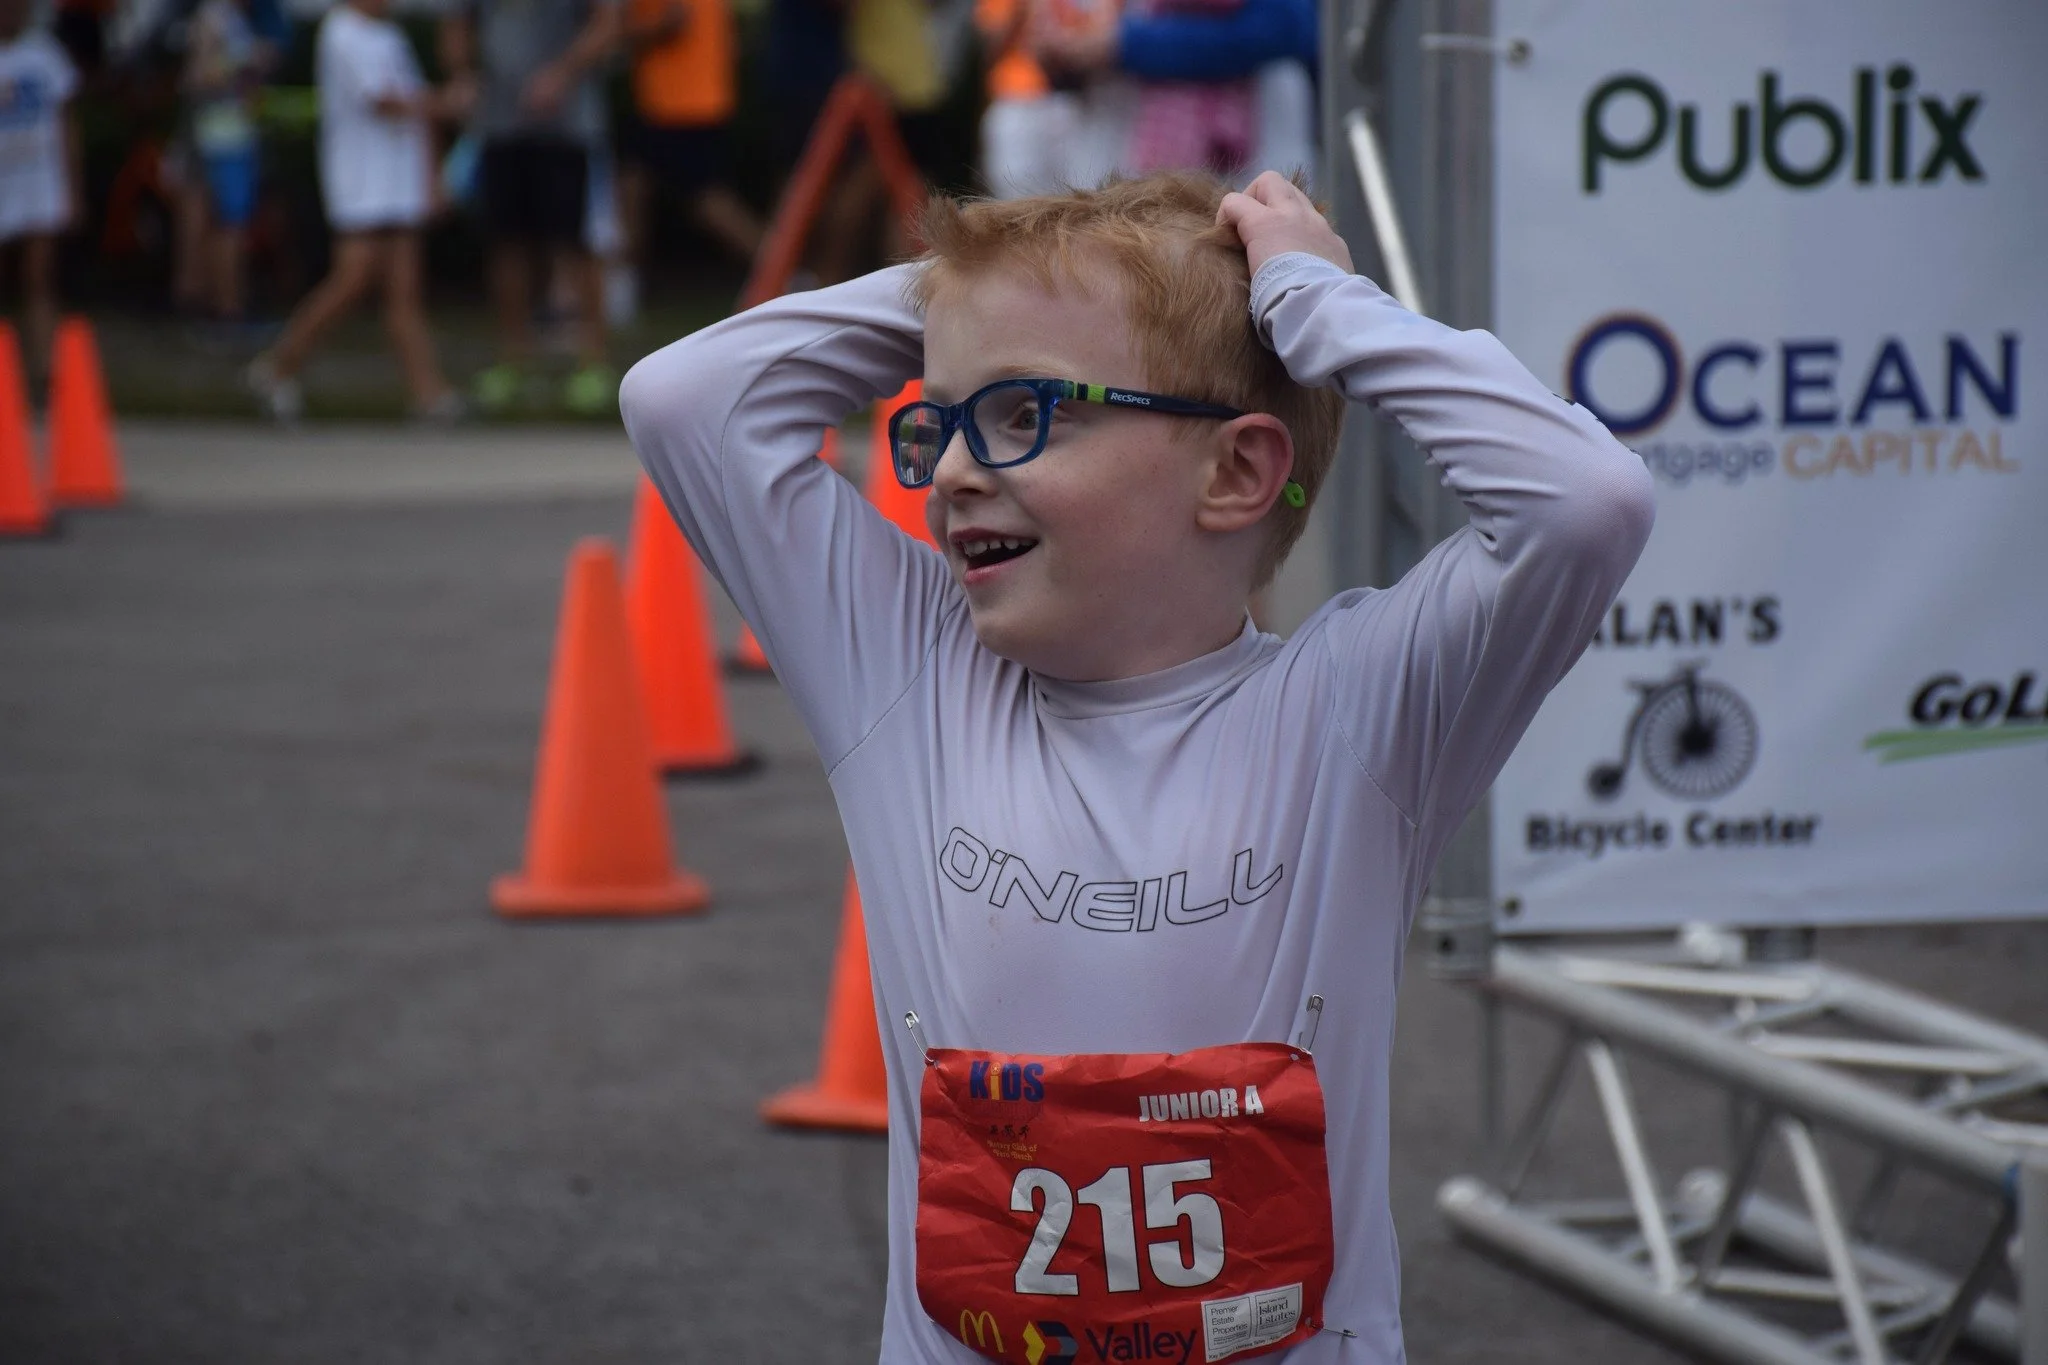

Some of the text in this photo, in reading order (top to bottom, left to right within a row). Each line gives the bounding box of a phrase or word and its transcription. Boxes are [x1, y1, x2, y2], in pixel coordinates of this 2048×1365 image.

[1582, 64, 1986, 193] Publix
[1566, 311, 2020, 438] OCEAN
[1641, 429, 2020, 487] tgage CAPITAL
[1594, 594, 1783, 646] LAN'S
[1910, 670, 2048, 724] GoL
[1526, 811, 1820, 858] Bicycle Center
[940, 827, 1283, 932] O'NEILL
[1138, 1085, 1265, 1122] JUNIOR A
[1010, 1158, 1225, 1296] 215
[1210, 1305, 1239, 1316] Premier
[1212, 1316, 1235, 1326] Estate
[1213, 1323, 1248, 1336] Properties
[1259, 1299, 1288, 1316] Island
[1085, 1321, 1198, 1365] Valley
